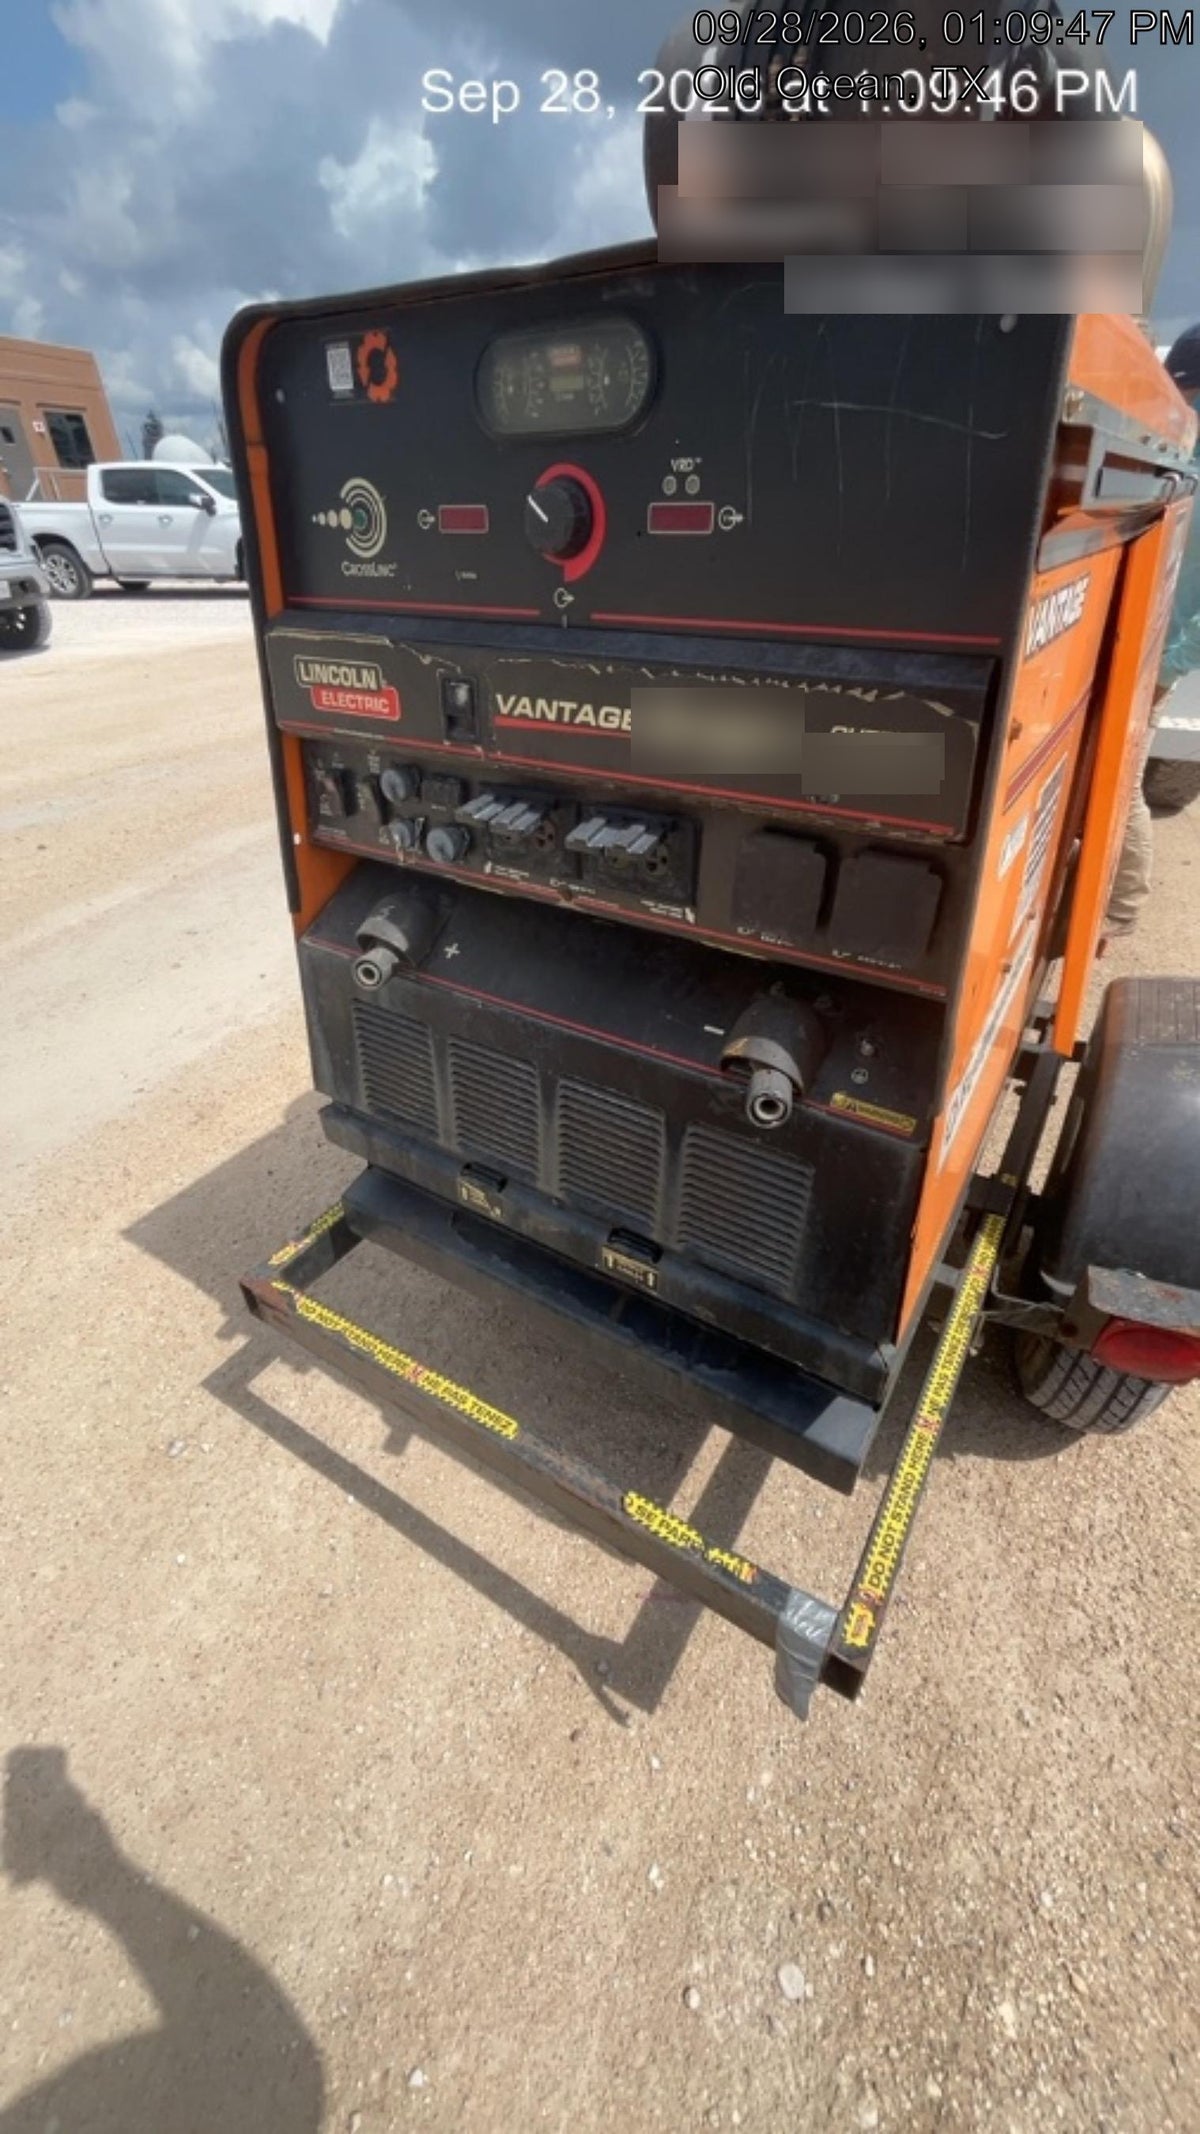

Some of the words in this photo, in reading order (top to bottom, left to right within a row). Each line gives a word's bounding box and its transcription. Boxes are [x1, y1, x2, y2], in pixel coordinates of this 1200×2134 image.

[299, 662, 379, 691] LINCOLN
[321, 691, 390, 714] ELECTRIC
[868, 1561, 886, 1589] DO
[879, 1525, 898, 1557] NOT
[891, 1471, 916, 1523] STAND
[908, 1432, 928, 1471] HERE
